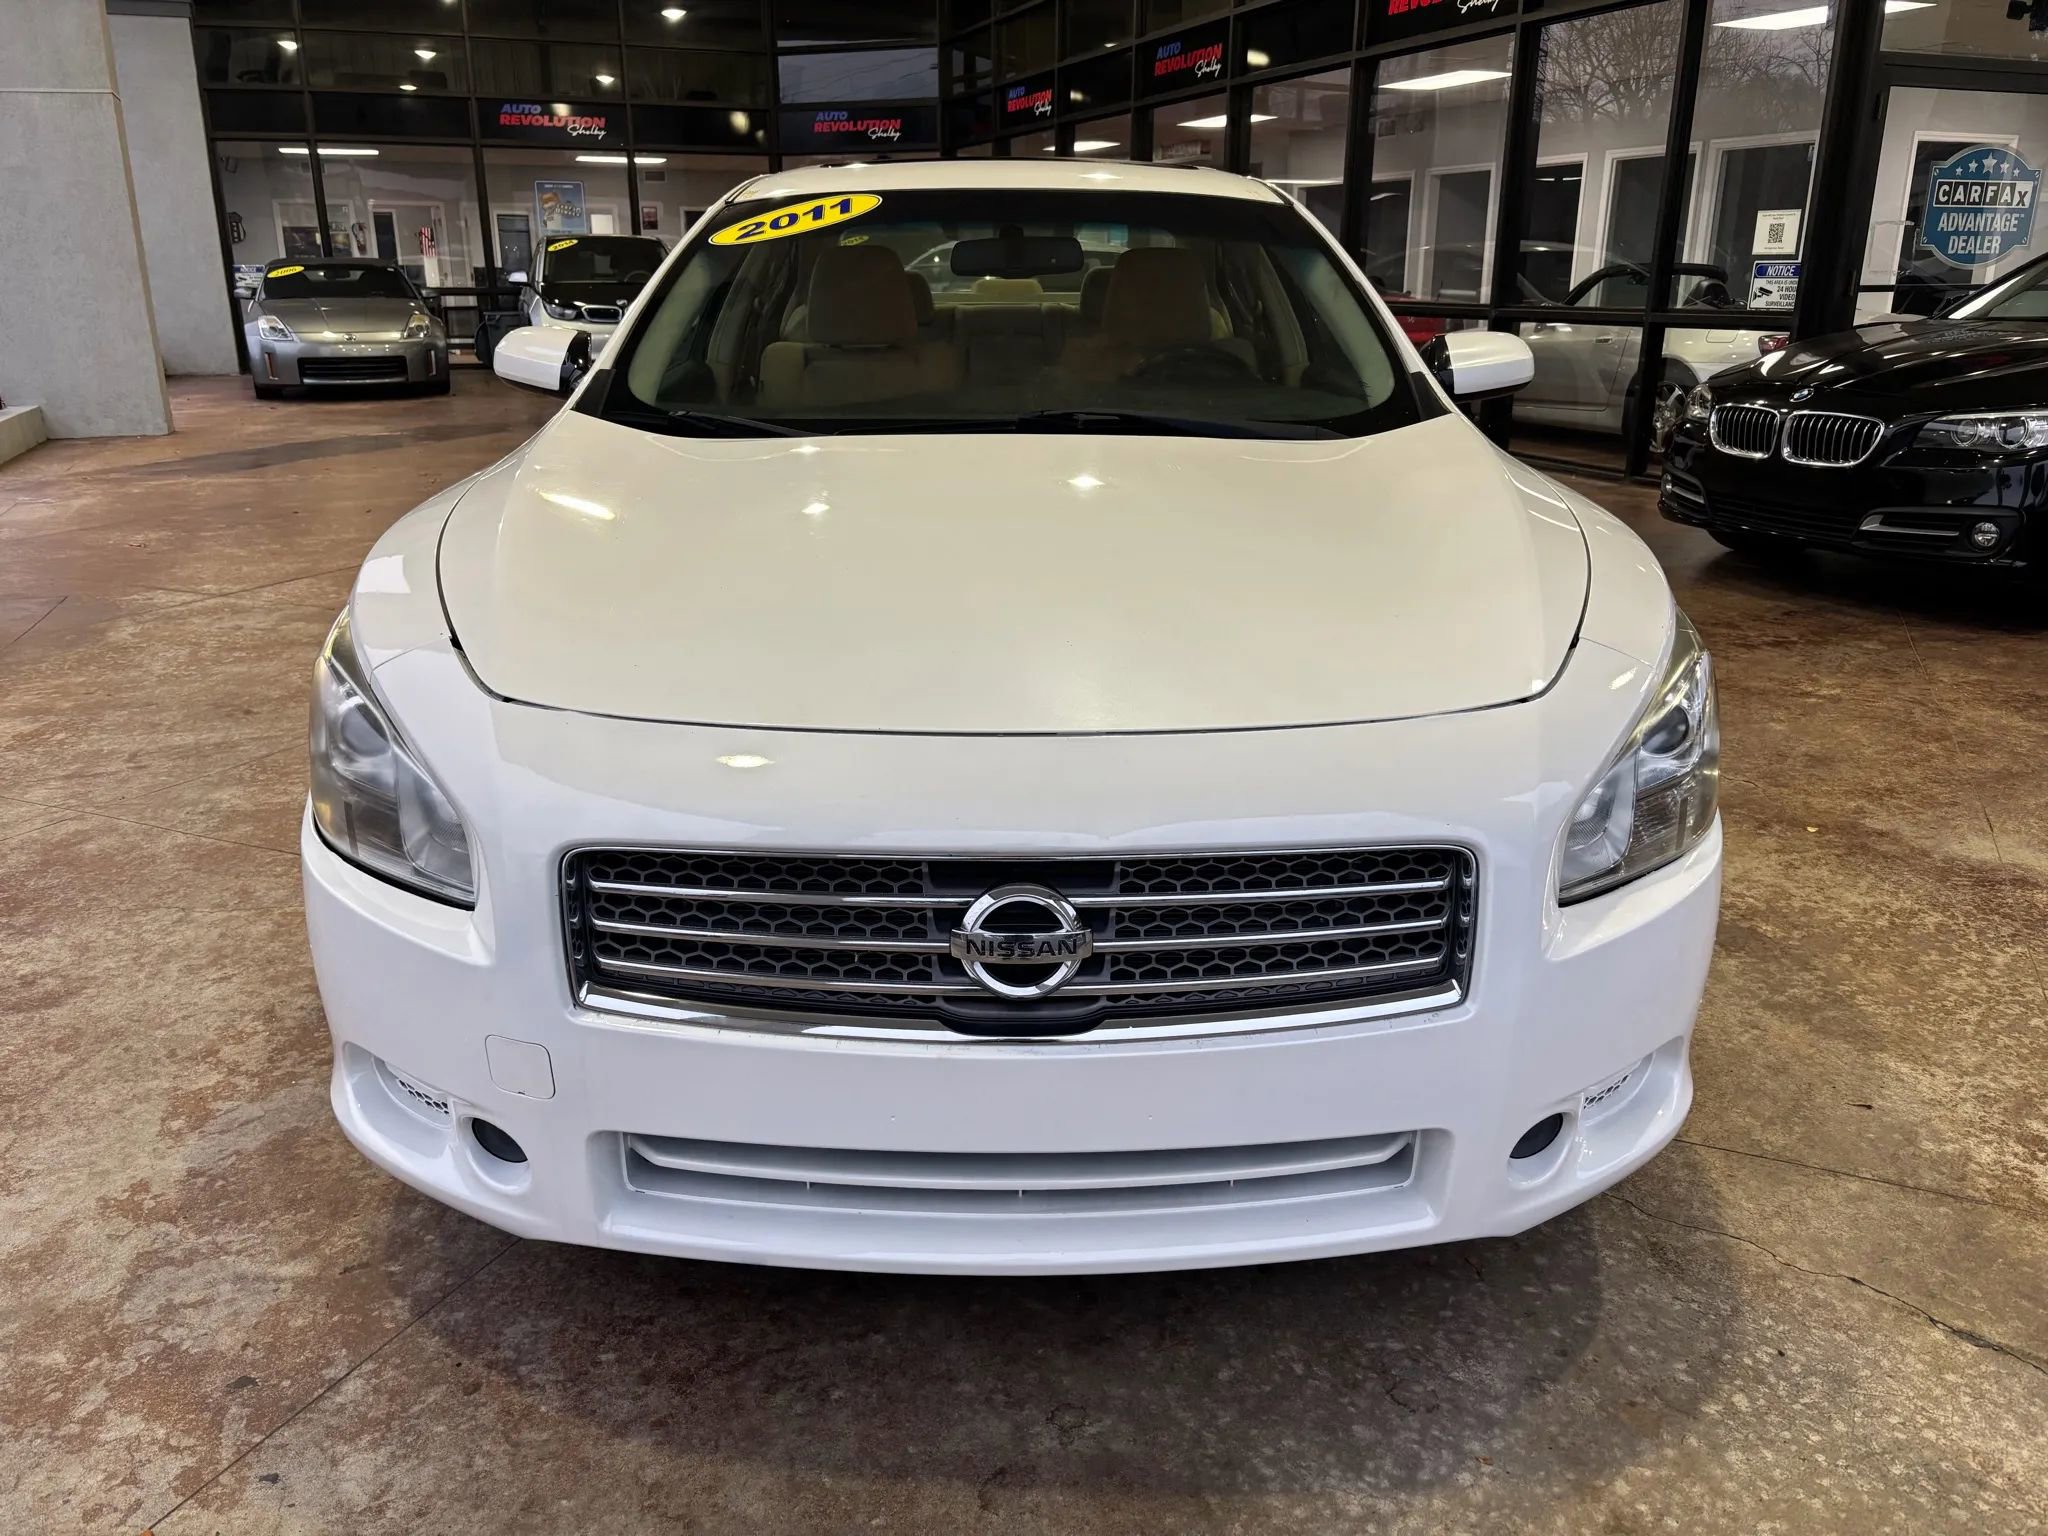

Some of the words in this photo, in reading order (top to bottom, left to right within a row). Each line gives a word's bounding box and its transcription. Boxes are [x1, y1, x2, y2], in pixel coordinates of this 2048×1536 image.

[1157, 42, 1181, 59] AUTO
[1155, 43, 1222, 76] REVOLUTION
[1194, 56, 1222, 78] Shelby
[1008, 89, 1052, 112] REVOLUTION
[1009, 86, 1025, 98] AUTO
[501, 103, 542, 114] AUTO
[816, 111, 848, 121] AUTO
[499, 114, 606, 128] REVOLUTION
[814, 119, 902, 132] REVOLUTION
[567, 123, 607, 140] Shelby
[867, 127, 902, 141] Shelby
[1938, 184, 2029, 206] CARFAX
[735, 198, 853, 241] 2011
[1948, 235, 2002, 254] DEALER
[1766, 265, 1795, 276] NOTICE
[966, 938, 1077, 958] NISSAN
